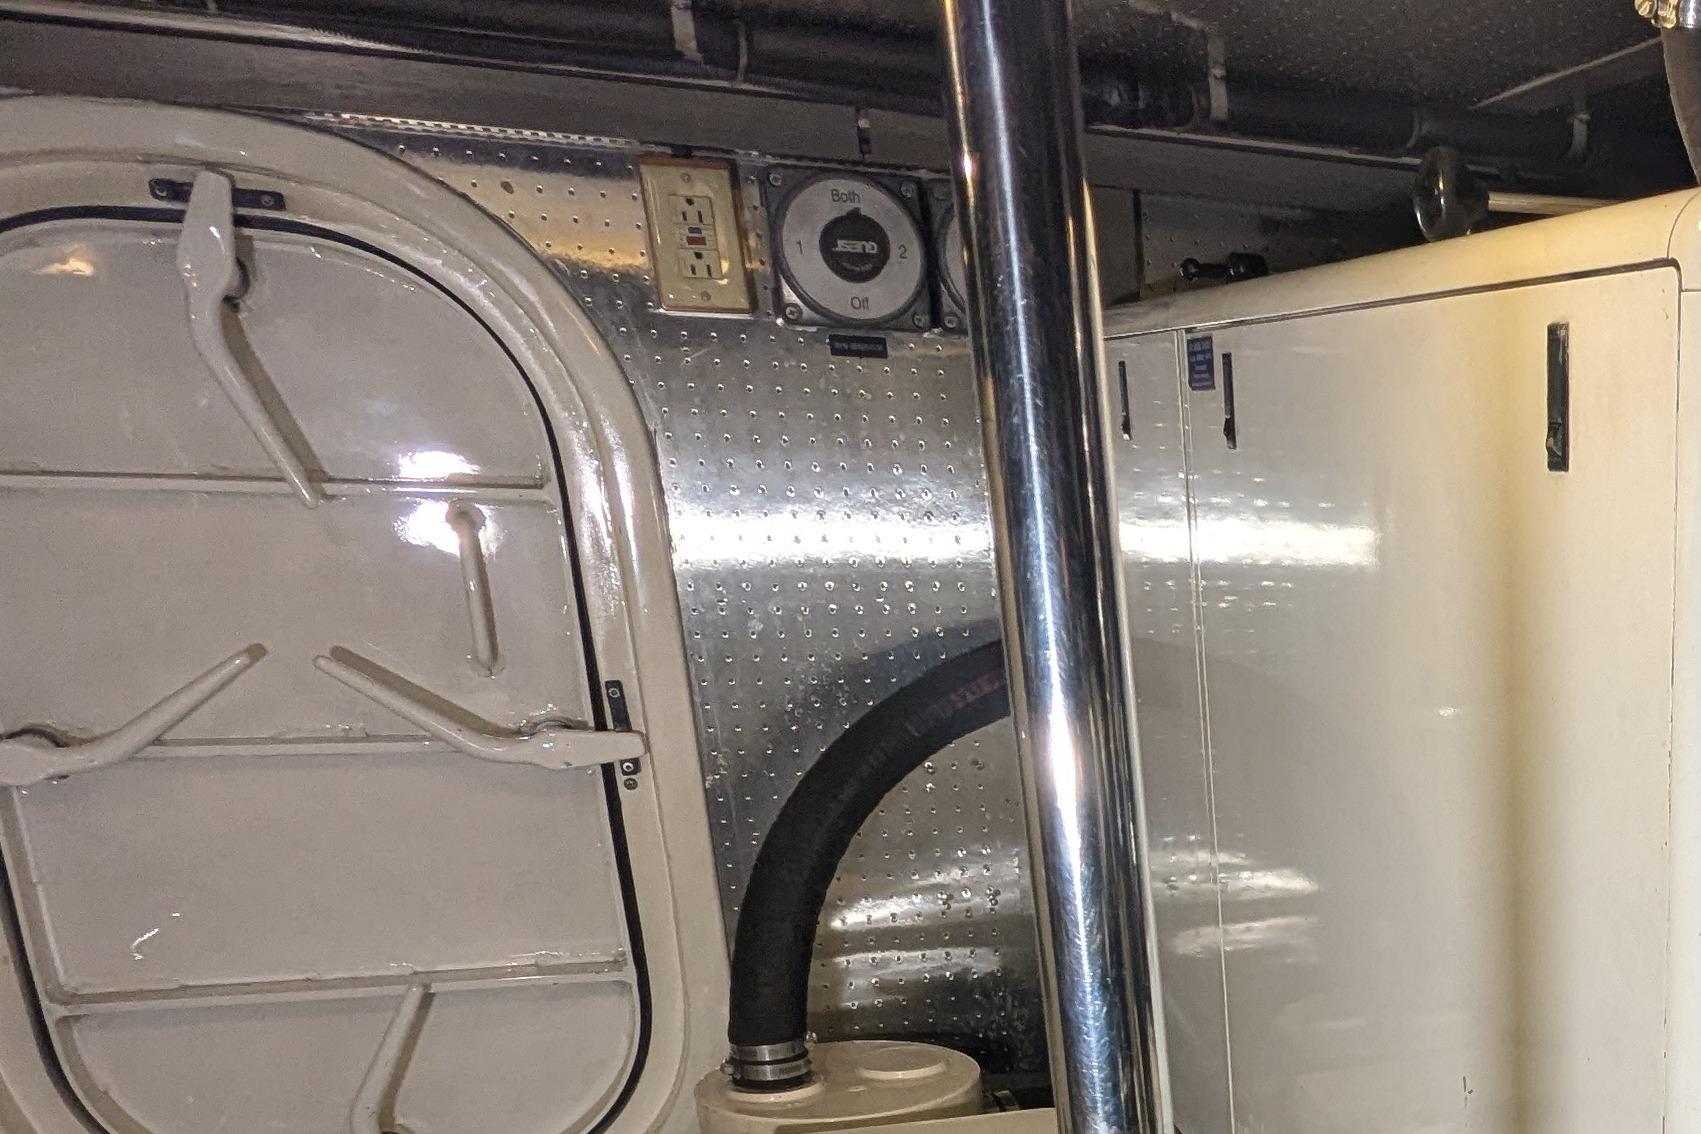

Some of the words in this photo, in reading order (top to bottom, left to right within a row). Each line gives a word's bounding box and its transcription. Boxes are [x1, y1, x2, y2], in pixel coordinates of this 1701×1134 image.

[831, 188, 861, 204] Both
[796, 240, 804, 255] 1
[898, 246, 909, 260] 2
[850, 296, 870, 311] Off
